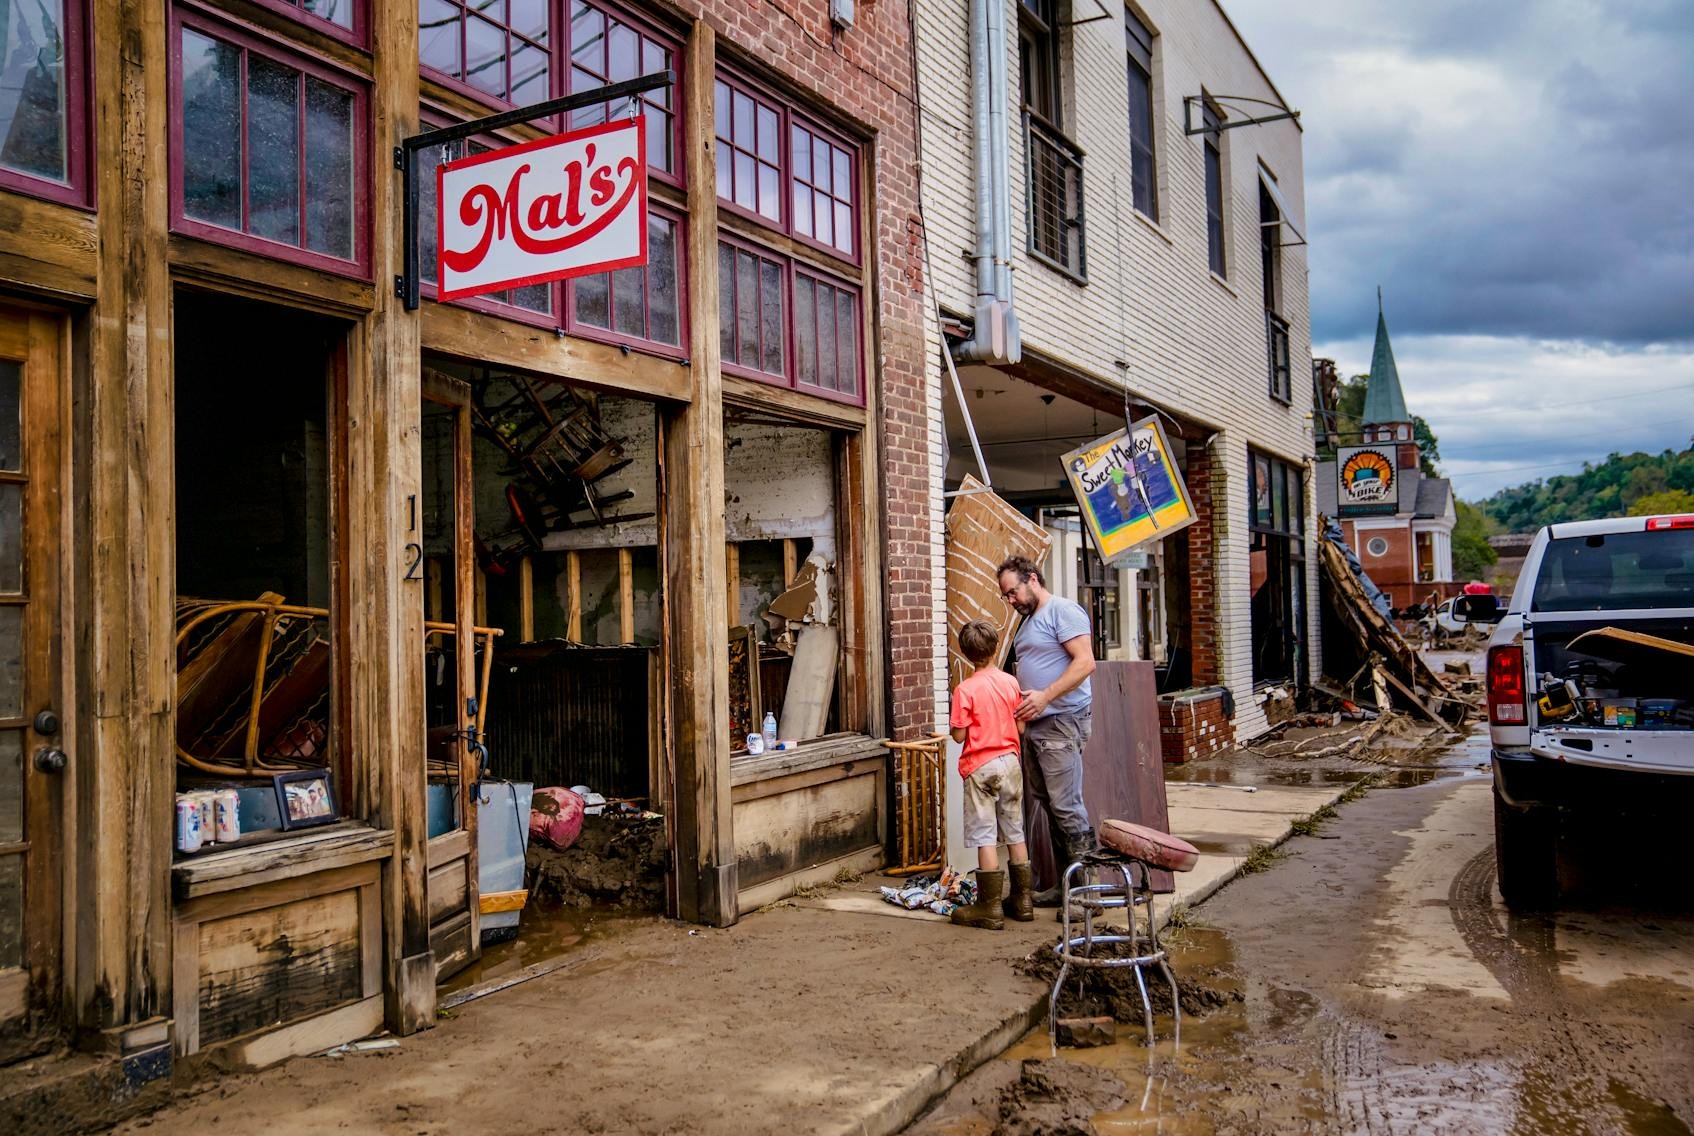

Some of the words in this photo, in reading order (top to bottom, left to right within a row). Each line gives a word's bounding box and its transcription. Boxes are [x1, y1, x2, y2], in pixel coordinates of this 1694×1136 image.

[443, 142, 639, 273] Mal's
[1081, 455, 1116, 493] Sweet
[1084, 450, 1100, 463] The
